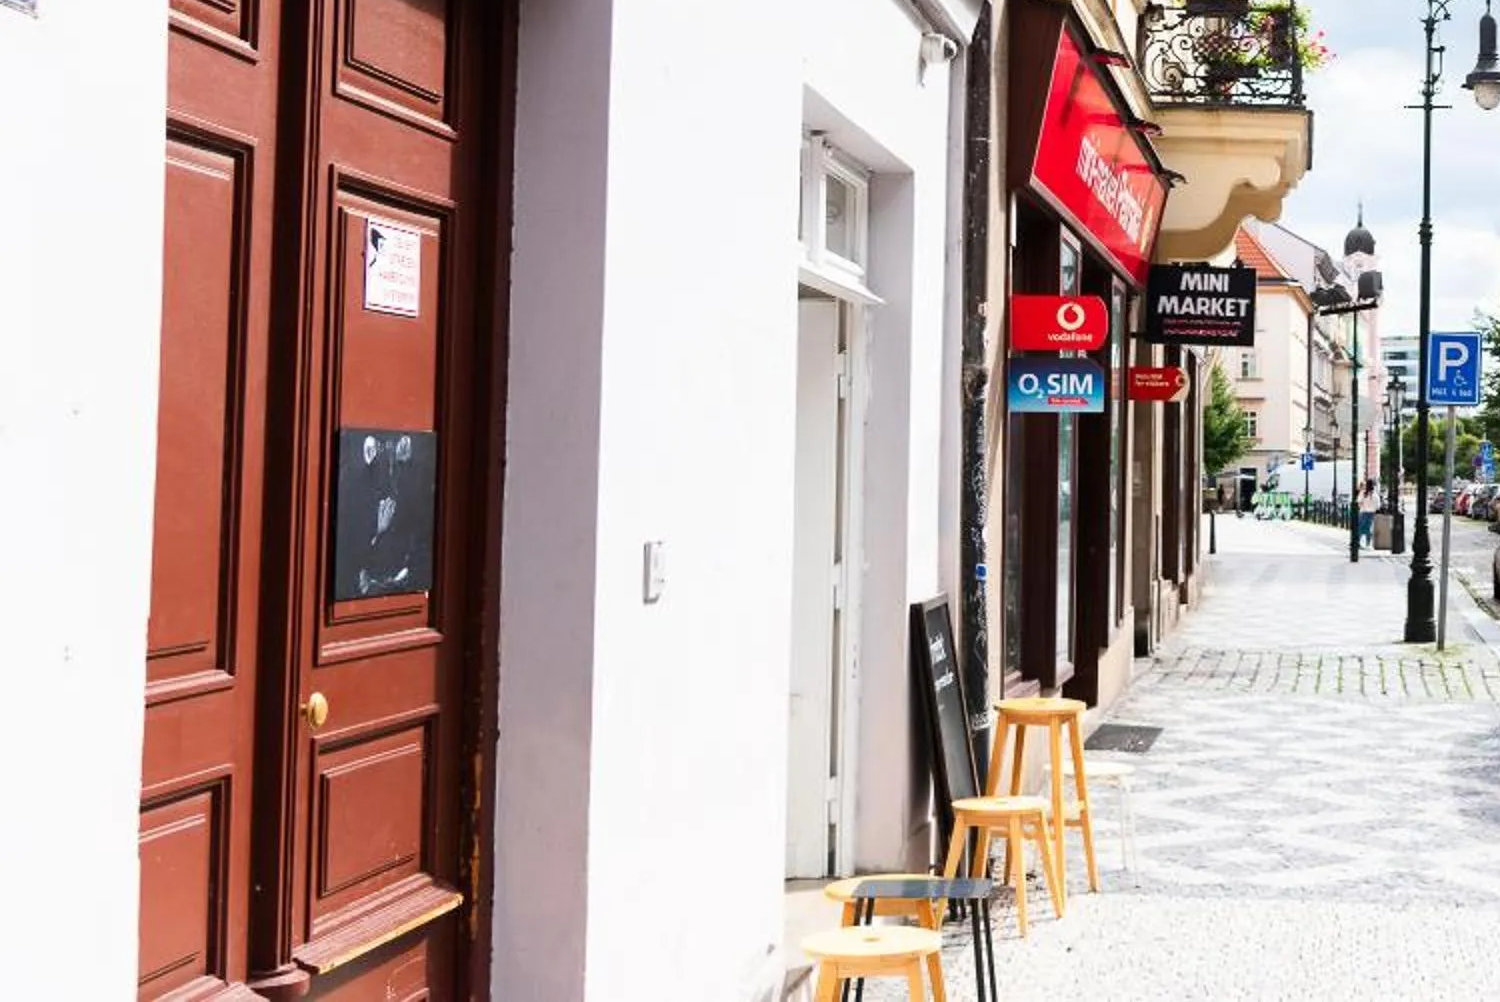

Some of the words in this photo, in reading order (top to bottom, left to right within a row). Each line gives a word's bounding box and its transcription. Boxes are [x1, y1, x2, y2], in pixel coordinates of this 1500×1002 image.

[1180, 271, 1230, 293] MINI
[1157, 295, 1250, 317] MARKET
[1047, 333, 1093, 343] vodafone
[1439, 341, 1469, 381] P
[1047, 373, 1093, 395] SIM
